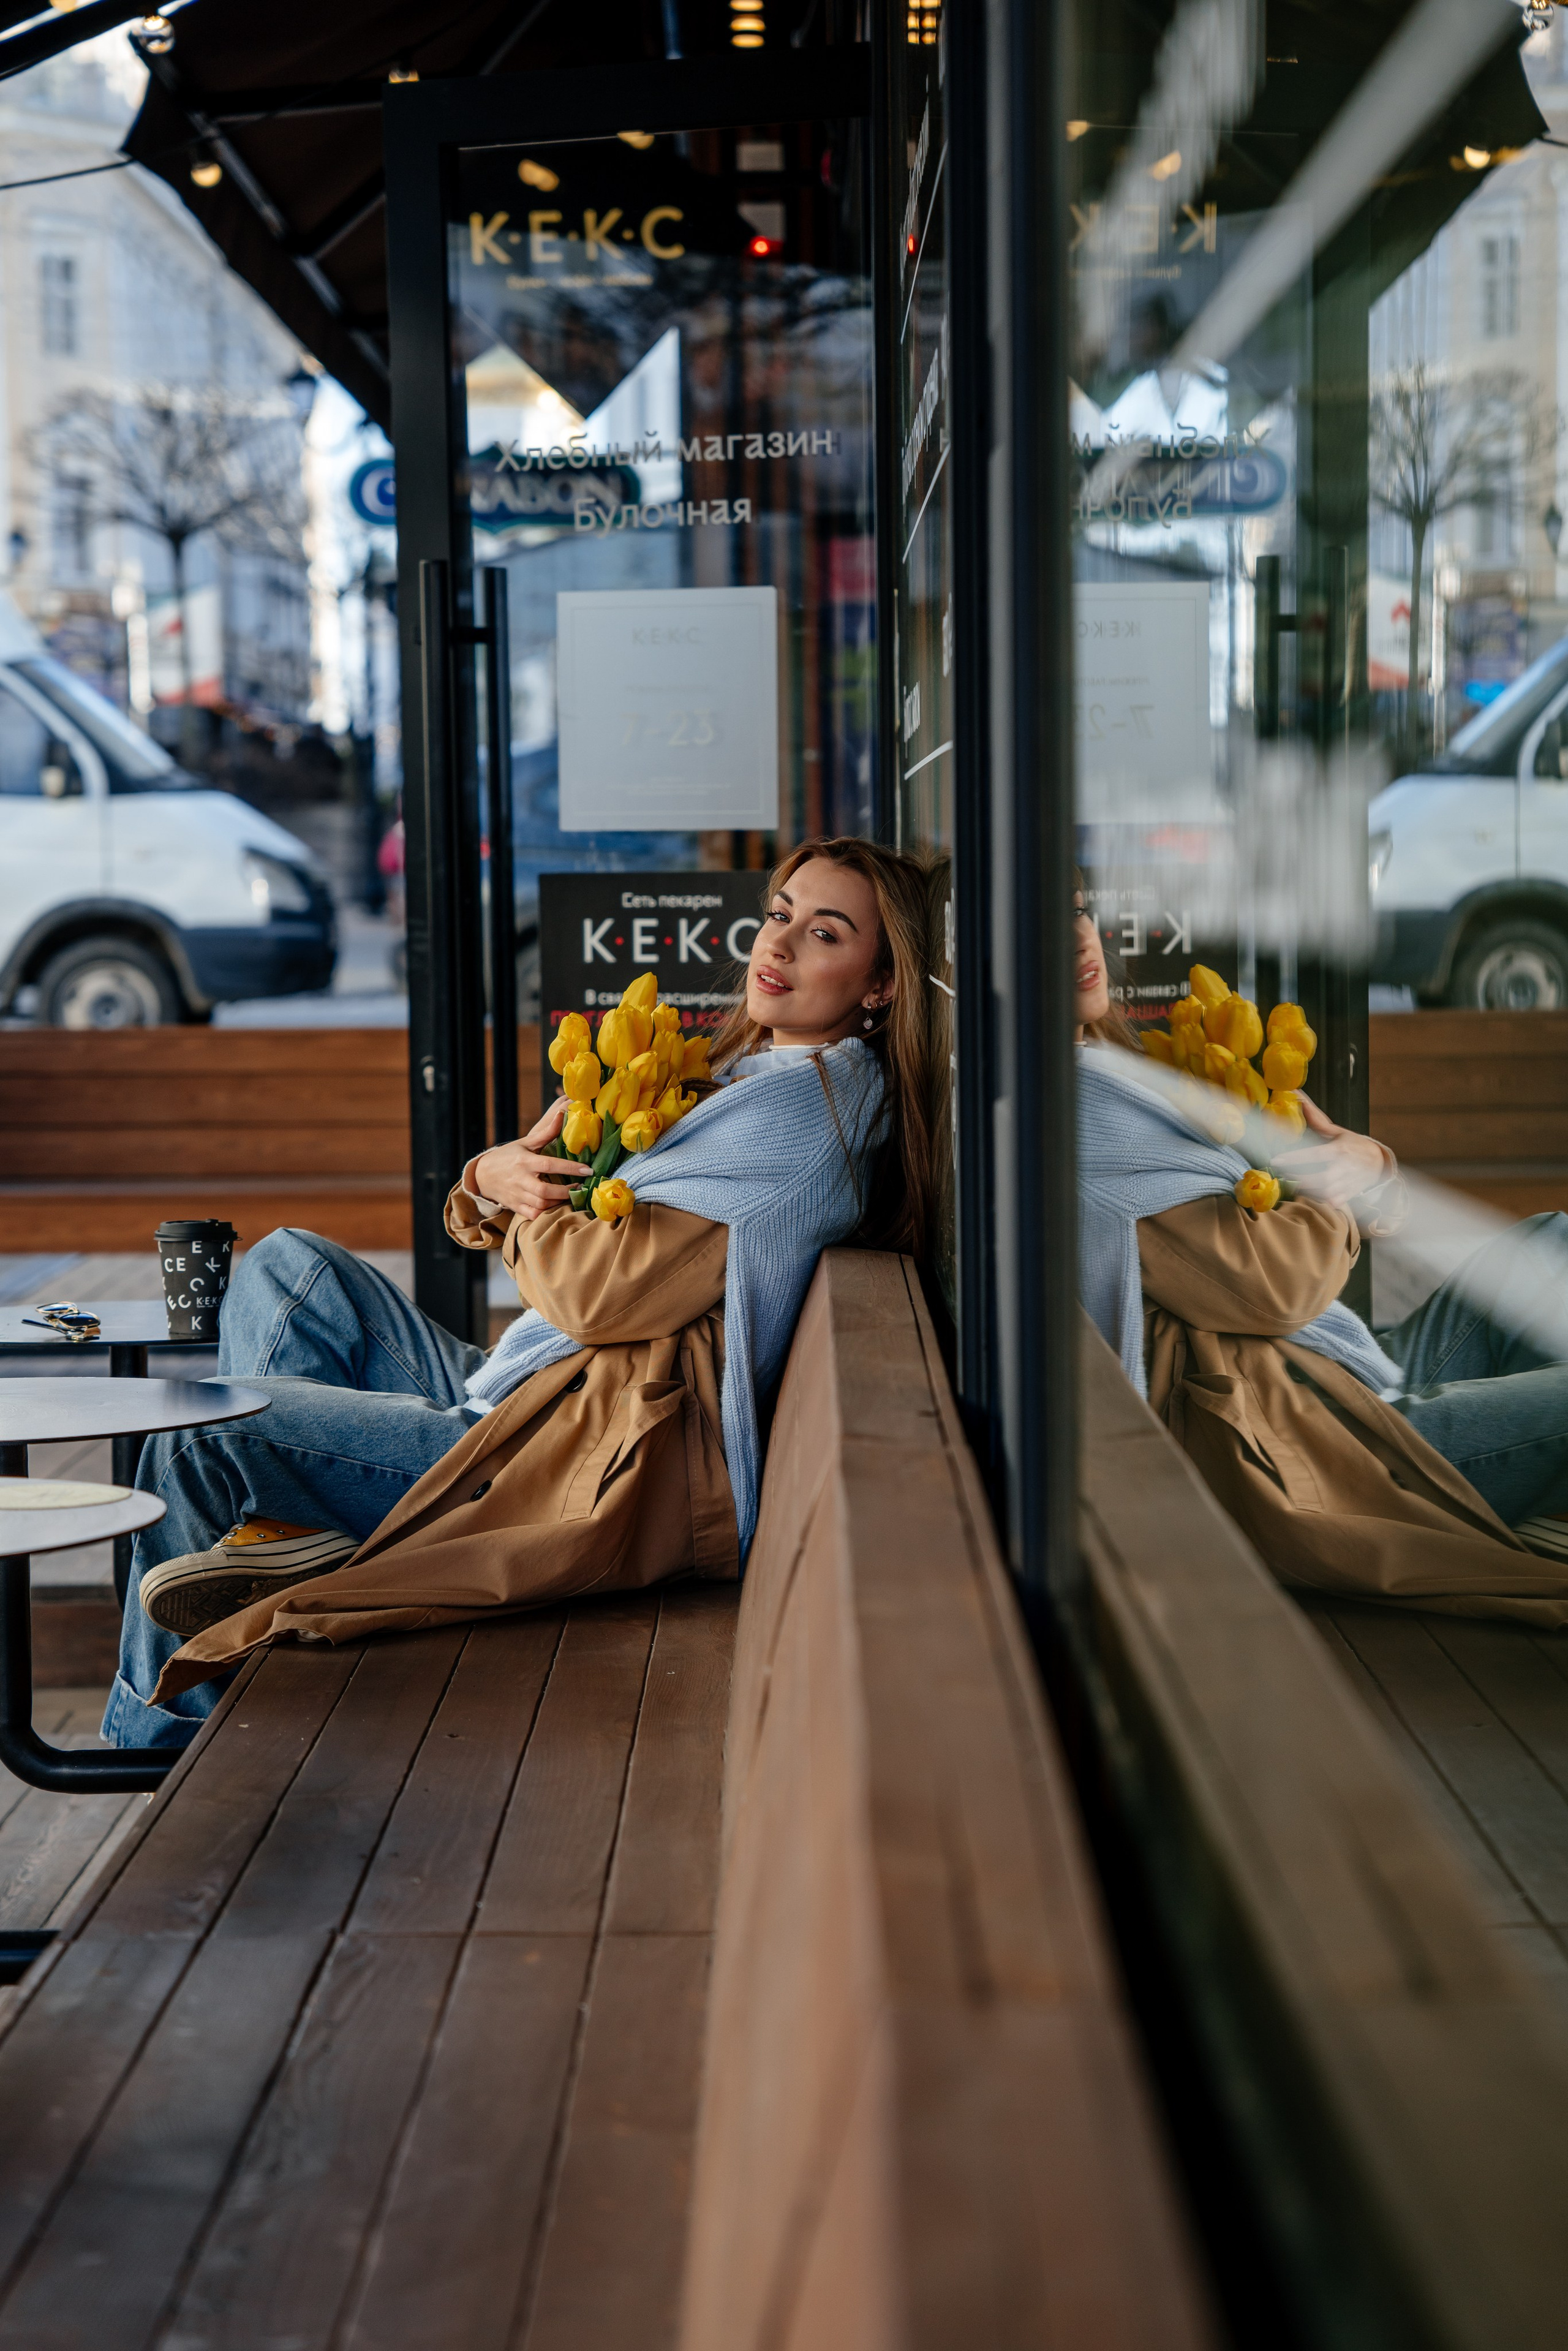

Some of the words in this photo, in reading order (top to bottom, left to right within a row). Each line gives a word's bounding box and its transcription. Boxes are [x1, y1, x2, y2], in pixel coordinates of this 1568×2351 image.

[494, 431, 663, 473] Хлебный
[677, 430, 834, 463] магазин
[573, 497, 752, 539] Булочная
[622, 892, 657, 908] Сеть
[658, 893, 723, 910] пекарен
[585, 989, 597, 1005] В
